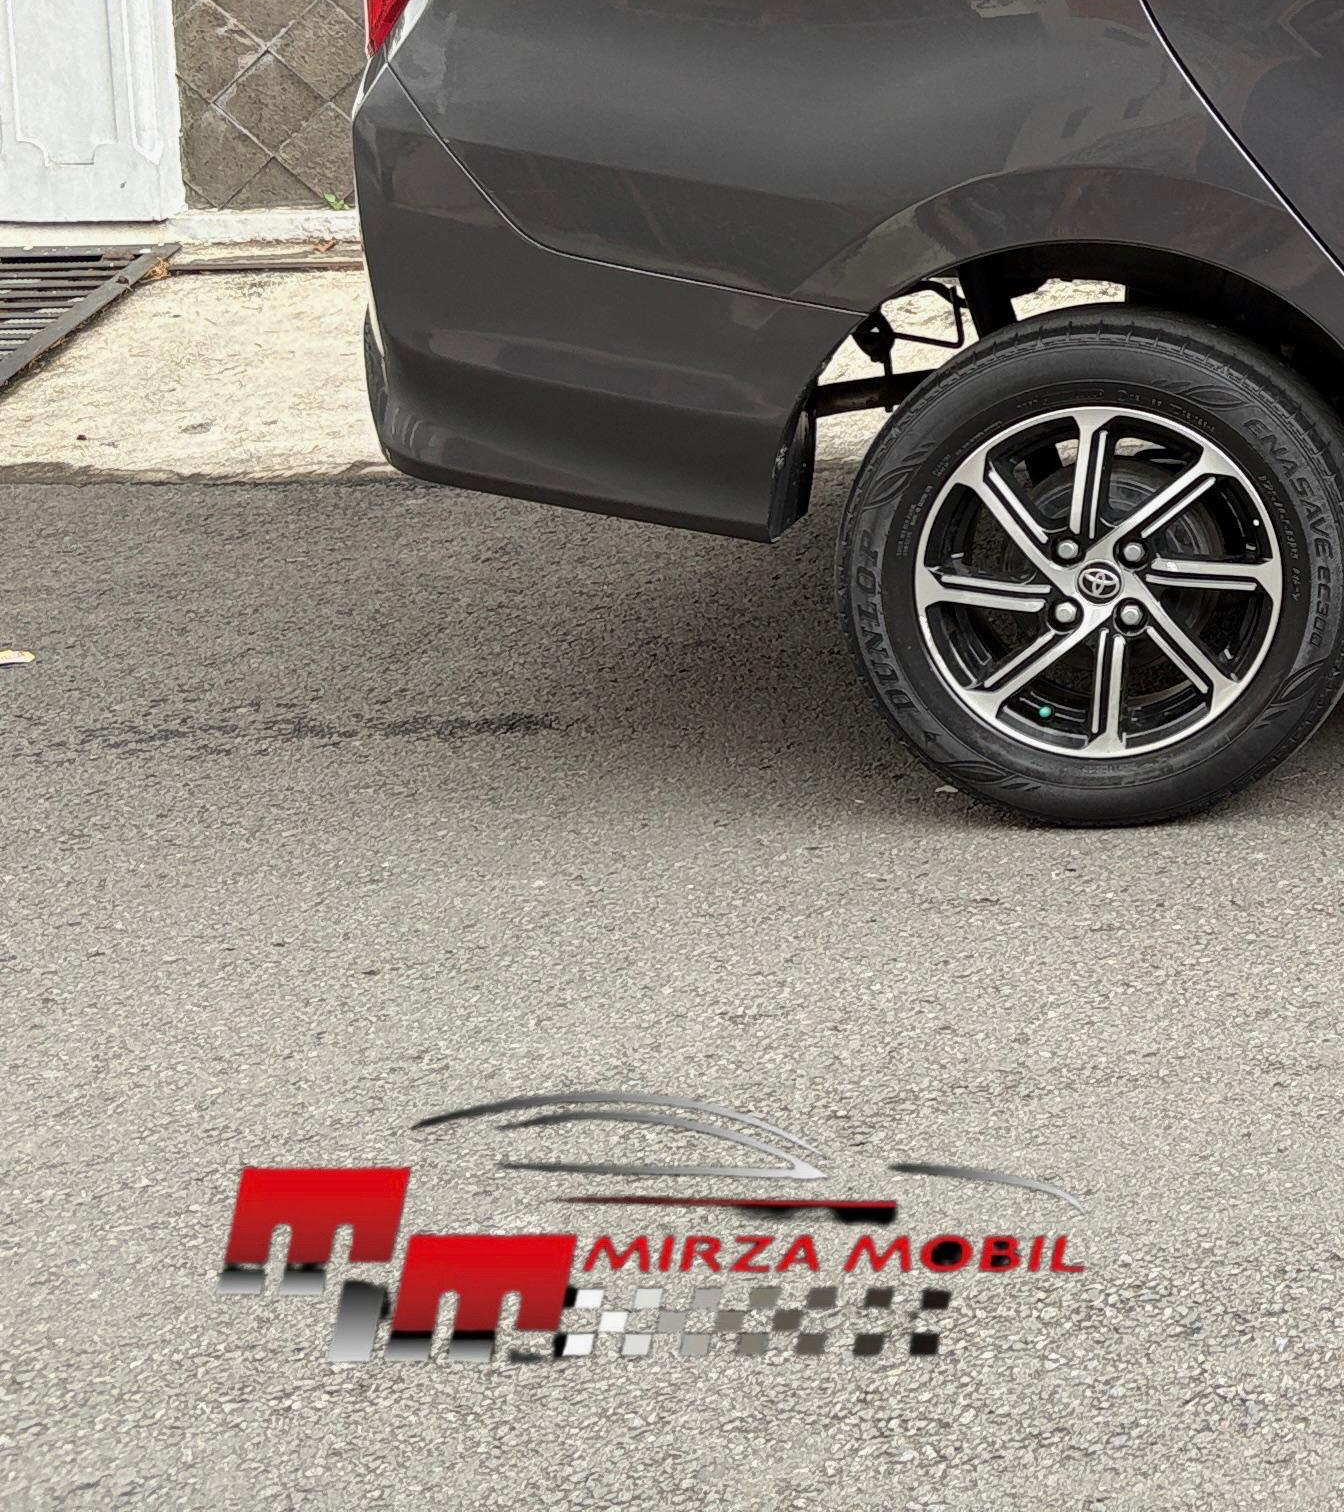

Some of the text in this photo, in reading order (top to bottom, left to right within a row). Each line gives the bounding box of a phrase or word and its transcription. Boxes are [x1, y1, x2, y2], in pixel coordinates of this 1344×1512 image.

[856, 529, 920, 713] DUNLOP
[1243, 419, 1334, 560] ENASAVE
[1310, 565, 1332, 648] EC300
